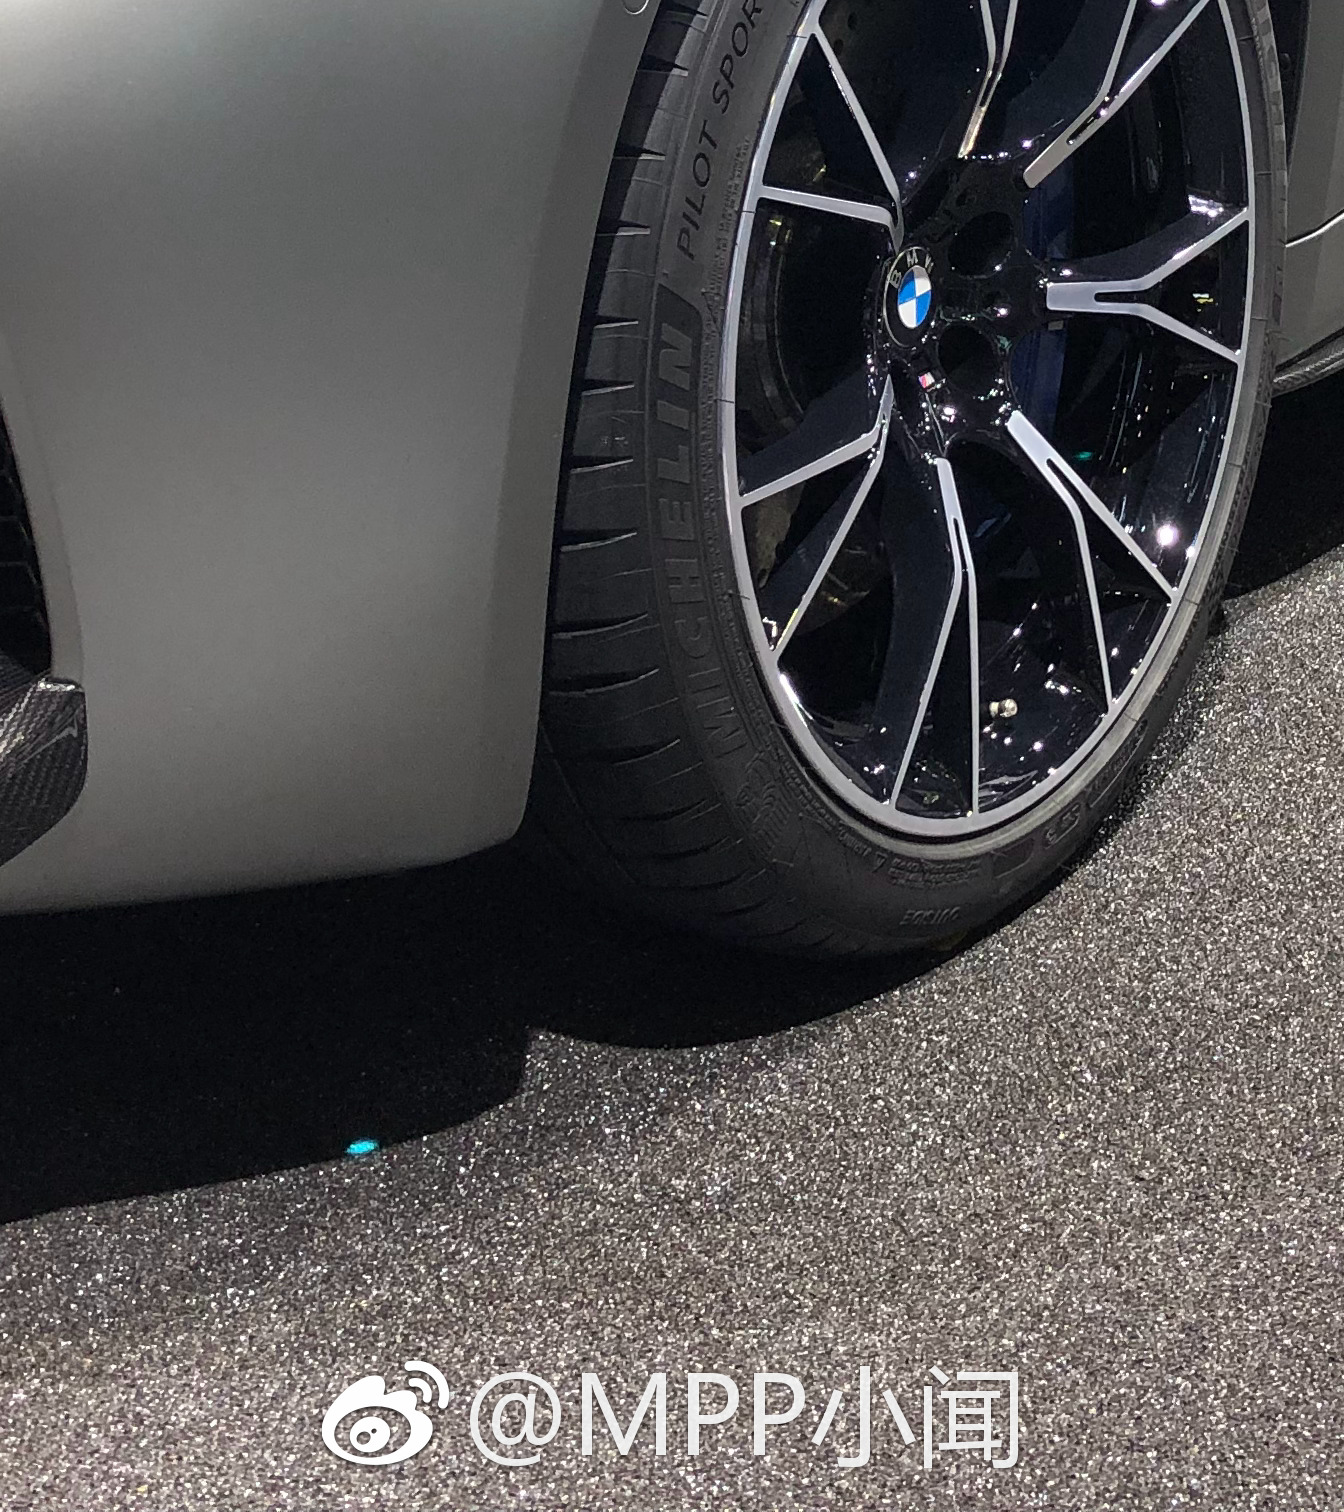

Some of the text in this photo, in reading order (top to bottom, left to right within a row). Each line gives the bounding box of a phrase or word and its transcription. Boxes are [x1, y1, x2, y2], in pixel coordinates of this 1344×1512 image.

[676, 119, 718, 261] PILOT
[888, 248, 935, 290] BMW
[657, 322, 748, 756] MICHELIN
